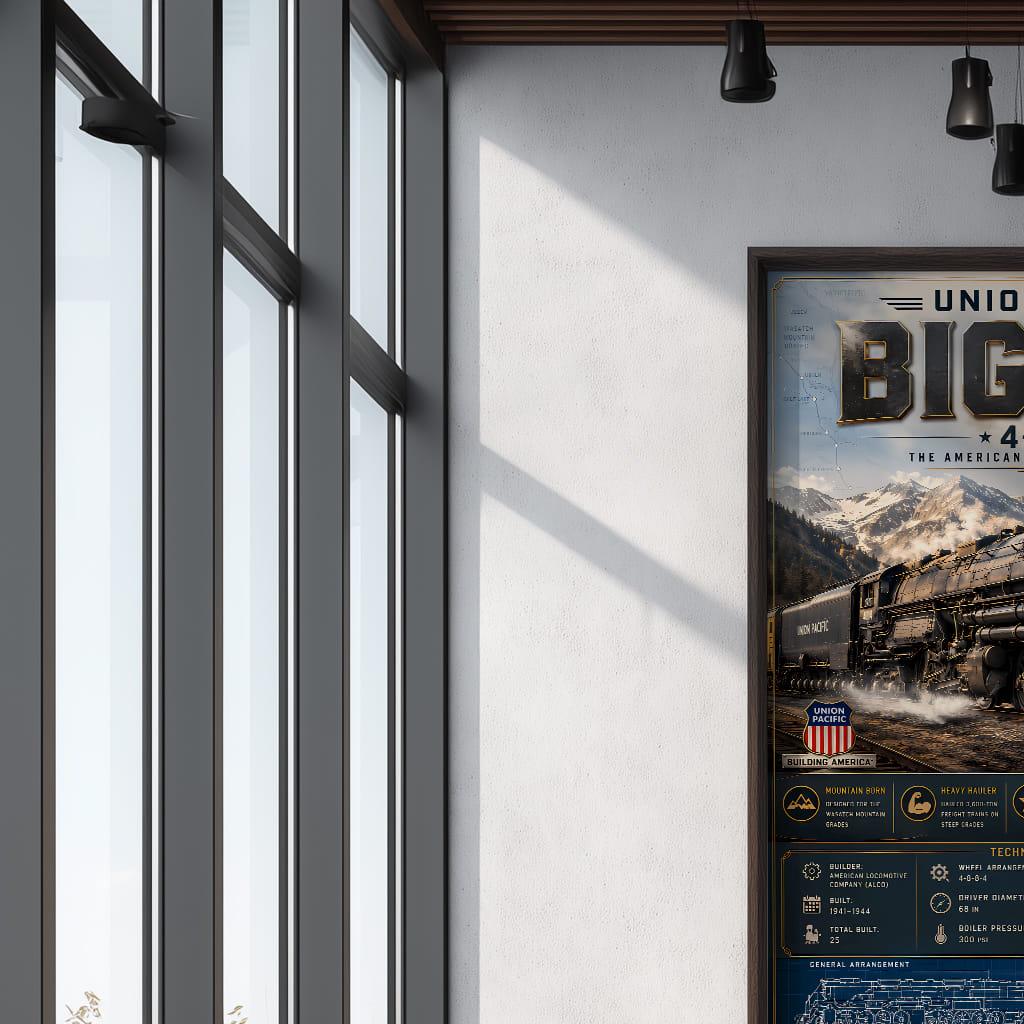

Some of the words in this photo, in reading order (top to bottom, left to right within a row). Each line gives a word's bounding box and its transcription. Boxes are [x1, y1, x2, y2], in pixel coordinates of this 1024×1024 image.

[909, 452, 935, 462] THE
[944, 452, 1020, 462] AMERICAN
[811, 620, 829, 633] PACIFIC
[814, 707, 844, 715] UNION
[825, 786, 863, 795] MOUNTAIN
[866, 786, 886, 795] BORN
[941, 786, 966, 795] HEAVY
[968, 786, 997, 795] HAULER
